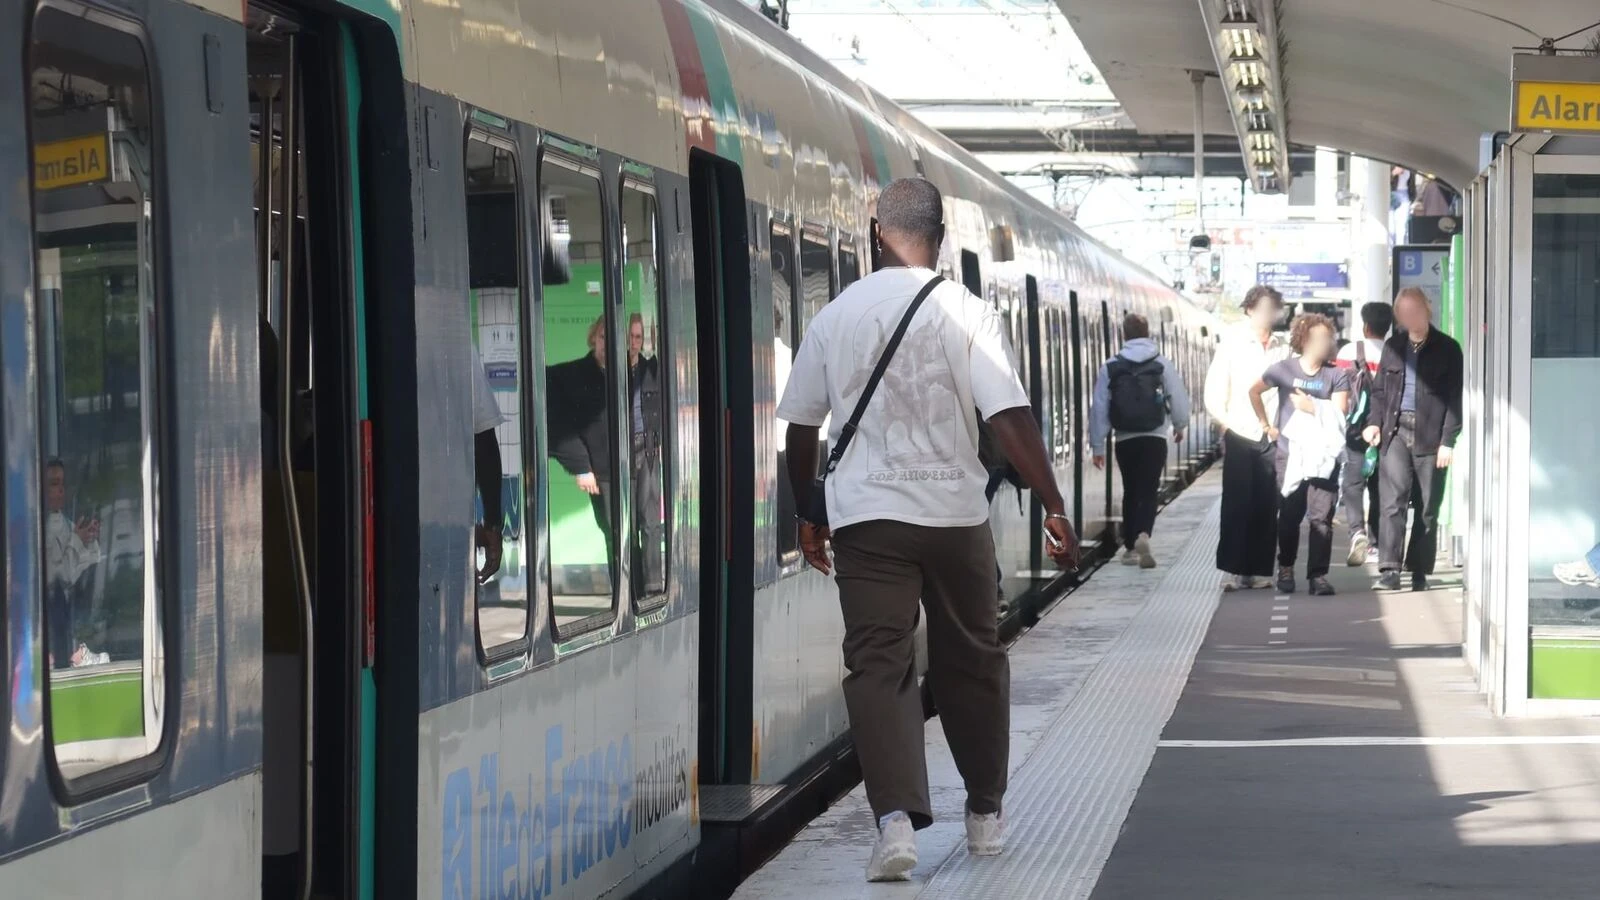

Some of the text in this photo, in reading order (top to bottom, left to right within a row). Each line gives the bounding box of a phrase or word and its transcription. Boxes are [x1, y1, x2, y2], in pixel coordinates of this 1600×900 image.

[1530, 94, 1600, 121] Alar
[1404, 255, 1416, 270] B
[635, 722, 687, 835] mobilités
